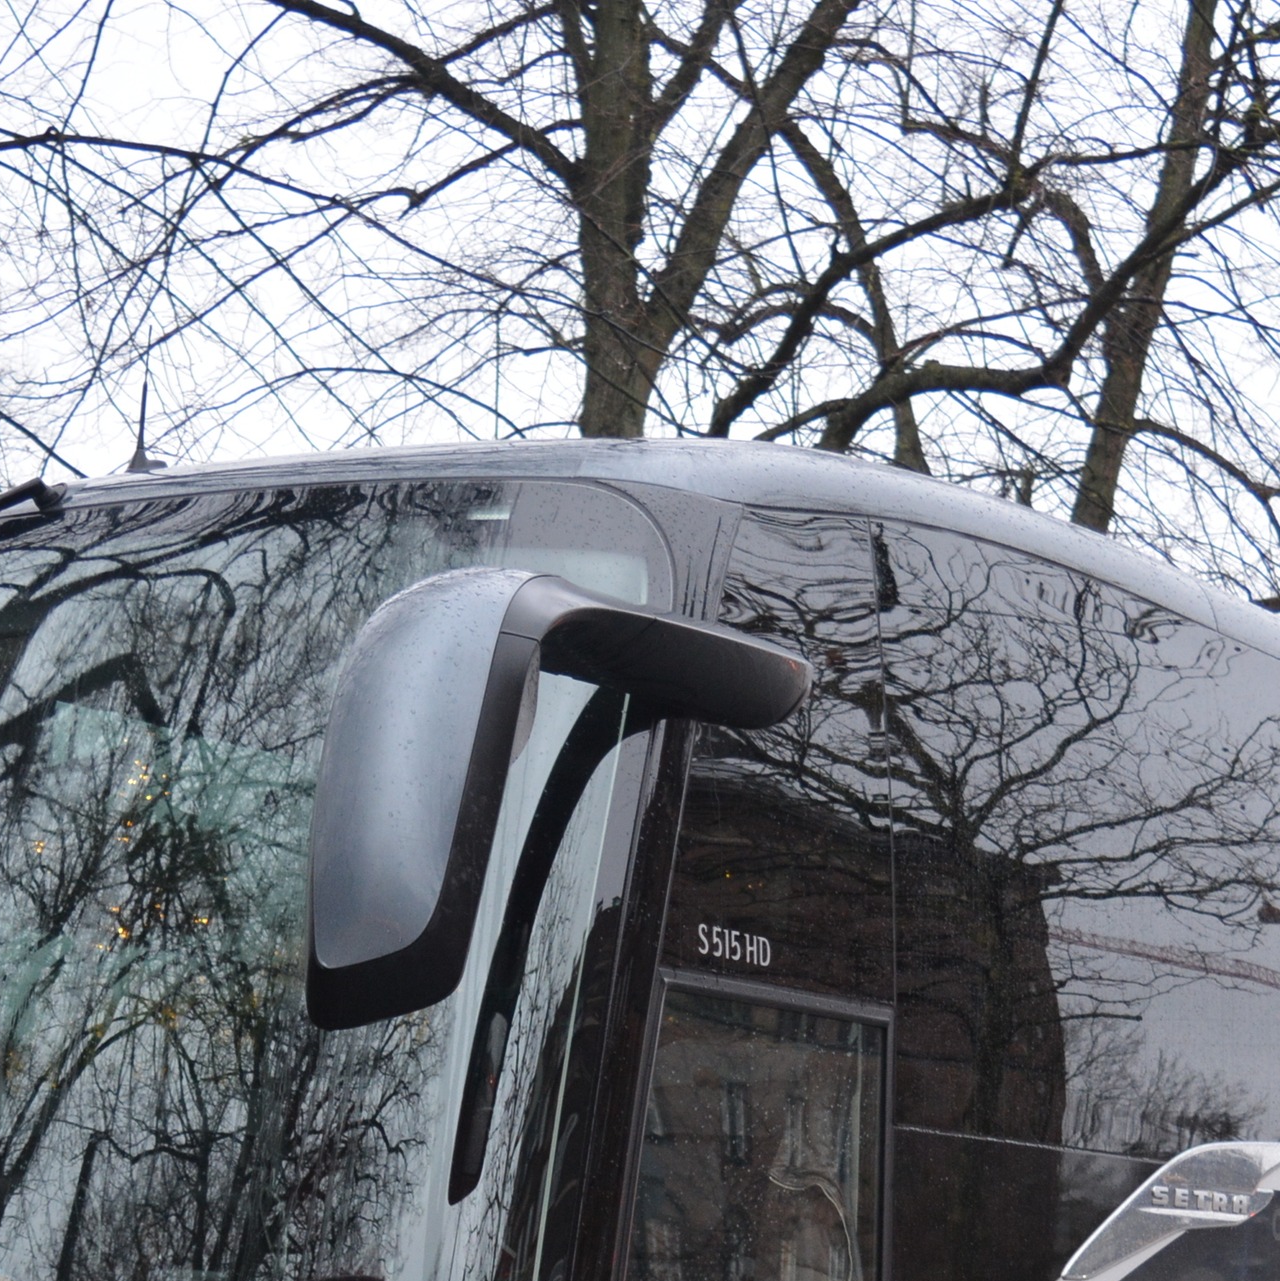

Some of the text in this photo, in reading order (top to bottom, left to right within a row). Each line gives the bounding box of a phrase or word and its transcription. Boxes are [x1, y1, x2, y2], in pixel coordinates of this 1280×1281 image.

[713, 927, 741, 961] 515
[744, 933, 770, 966] HD
[1152, 1186, 1251, 1213] SETRA
